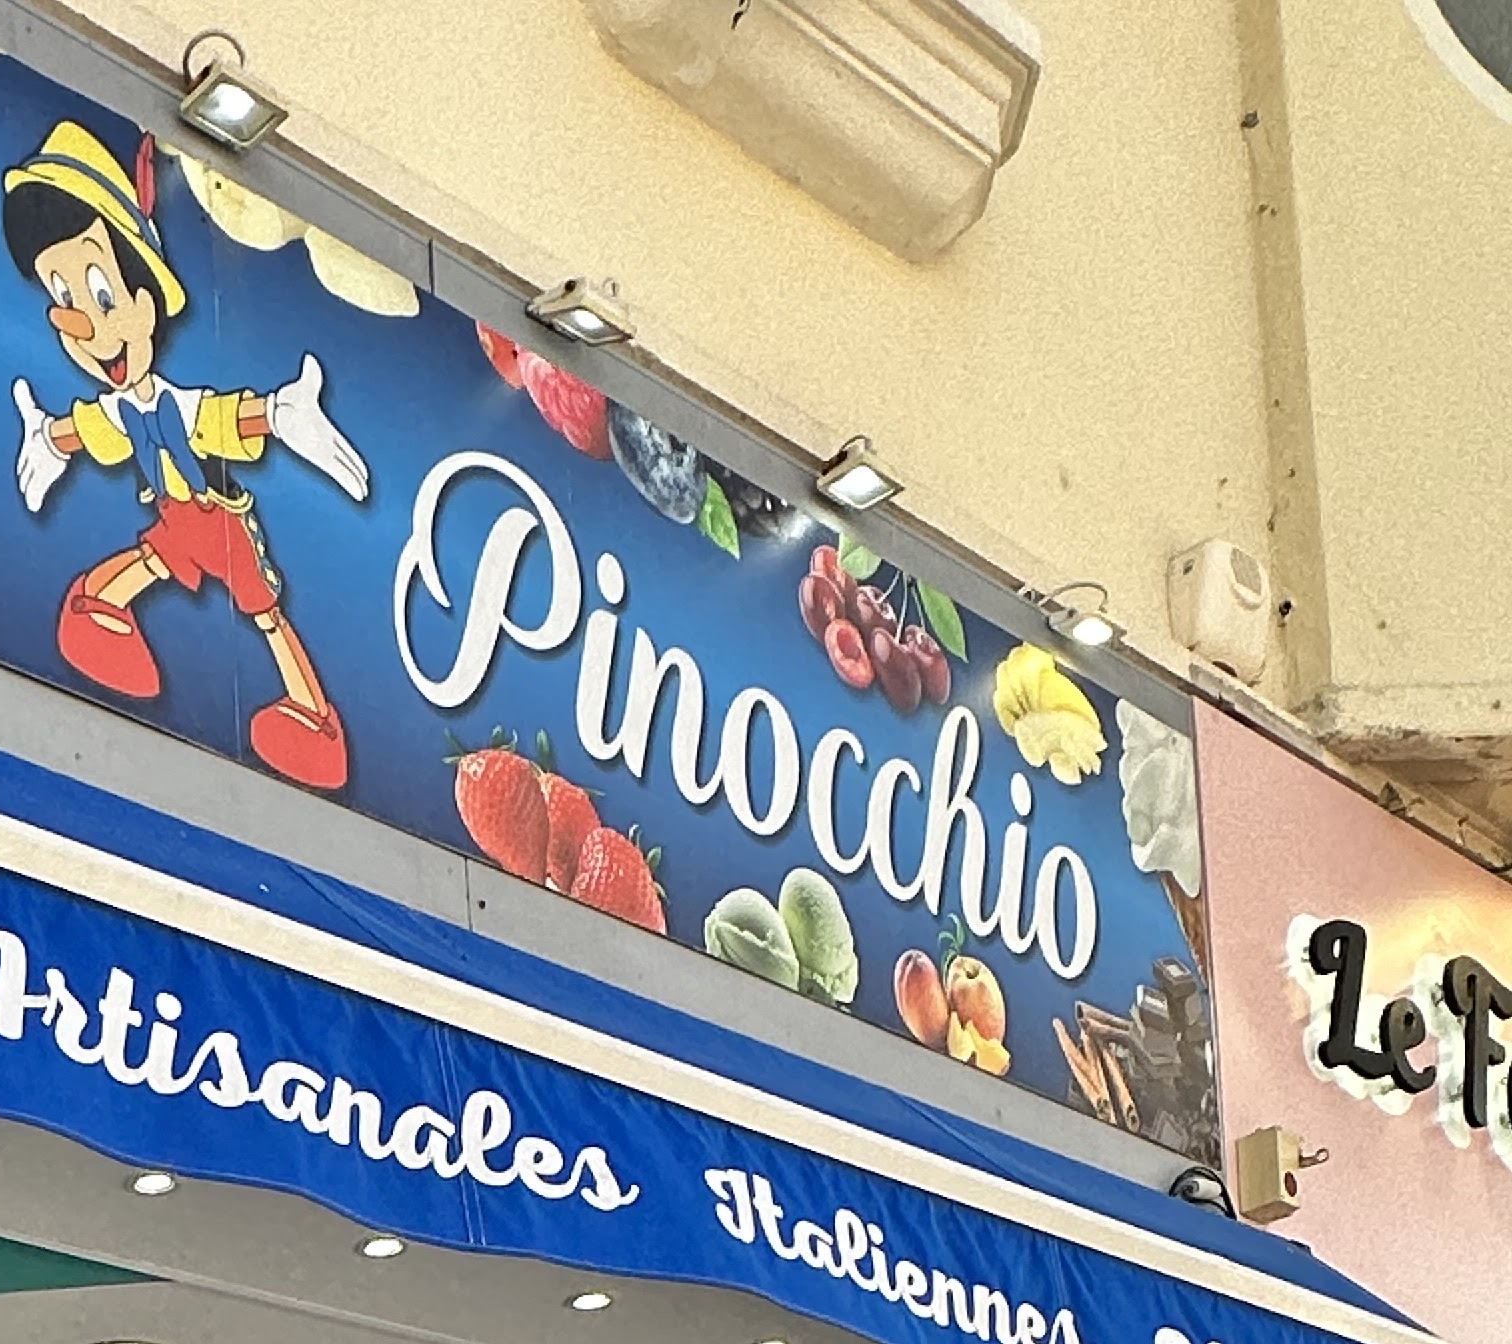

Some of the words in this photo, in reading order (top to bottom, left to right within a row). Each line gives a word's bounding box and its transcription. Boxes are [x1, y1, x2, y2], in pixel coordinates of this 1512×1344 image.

[393, 451, 1103, 982] Pinocchio
[1308, 918, 1436, 1093] Le
[1443, 956, 1512, 1128] F
